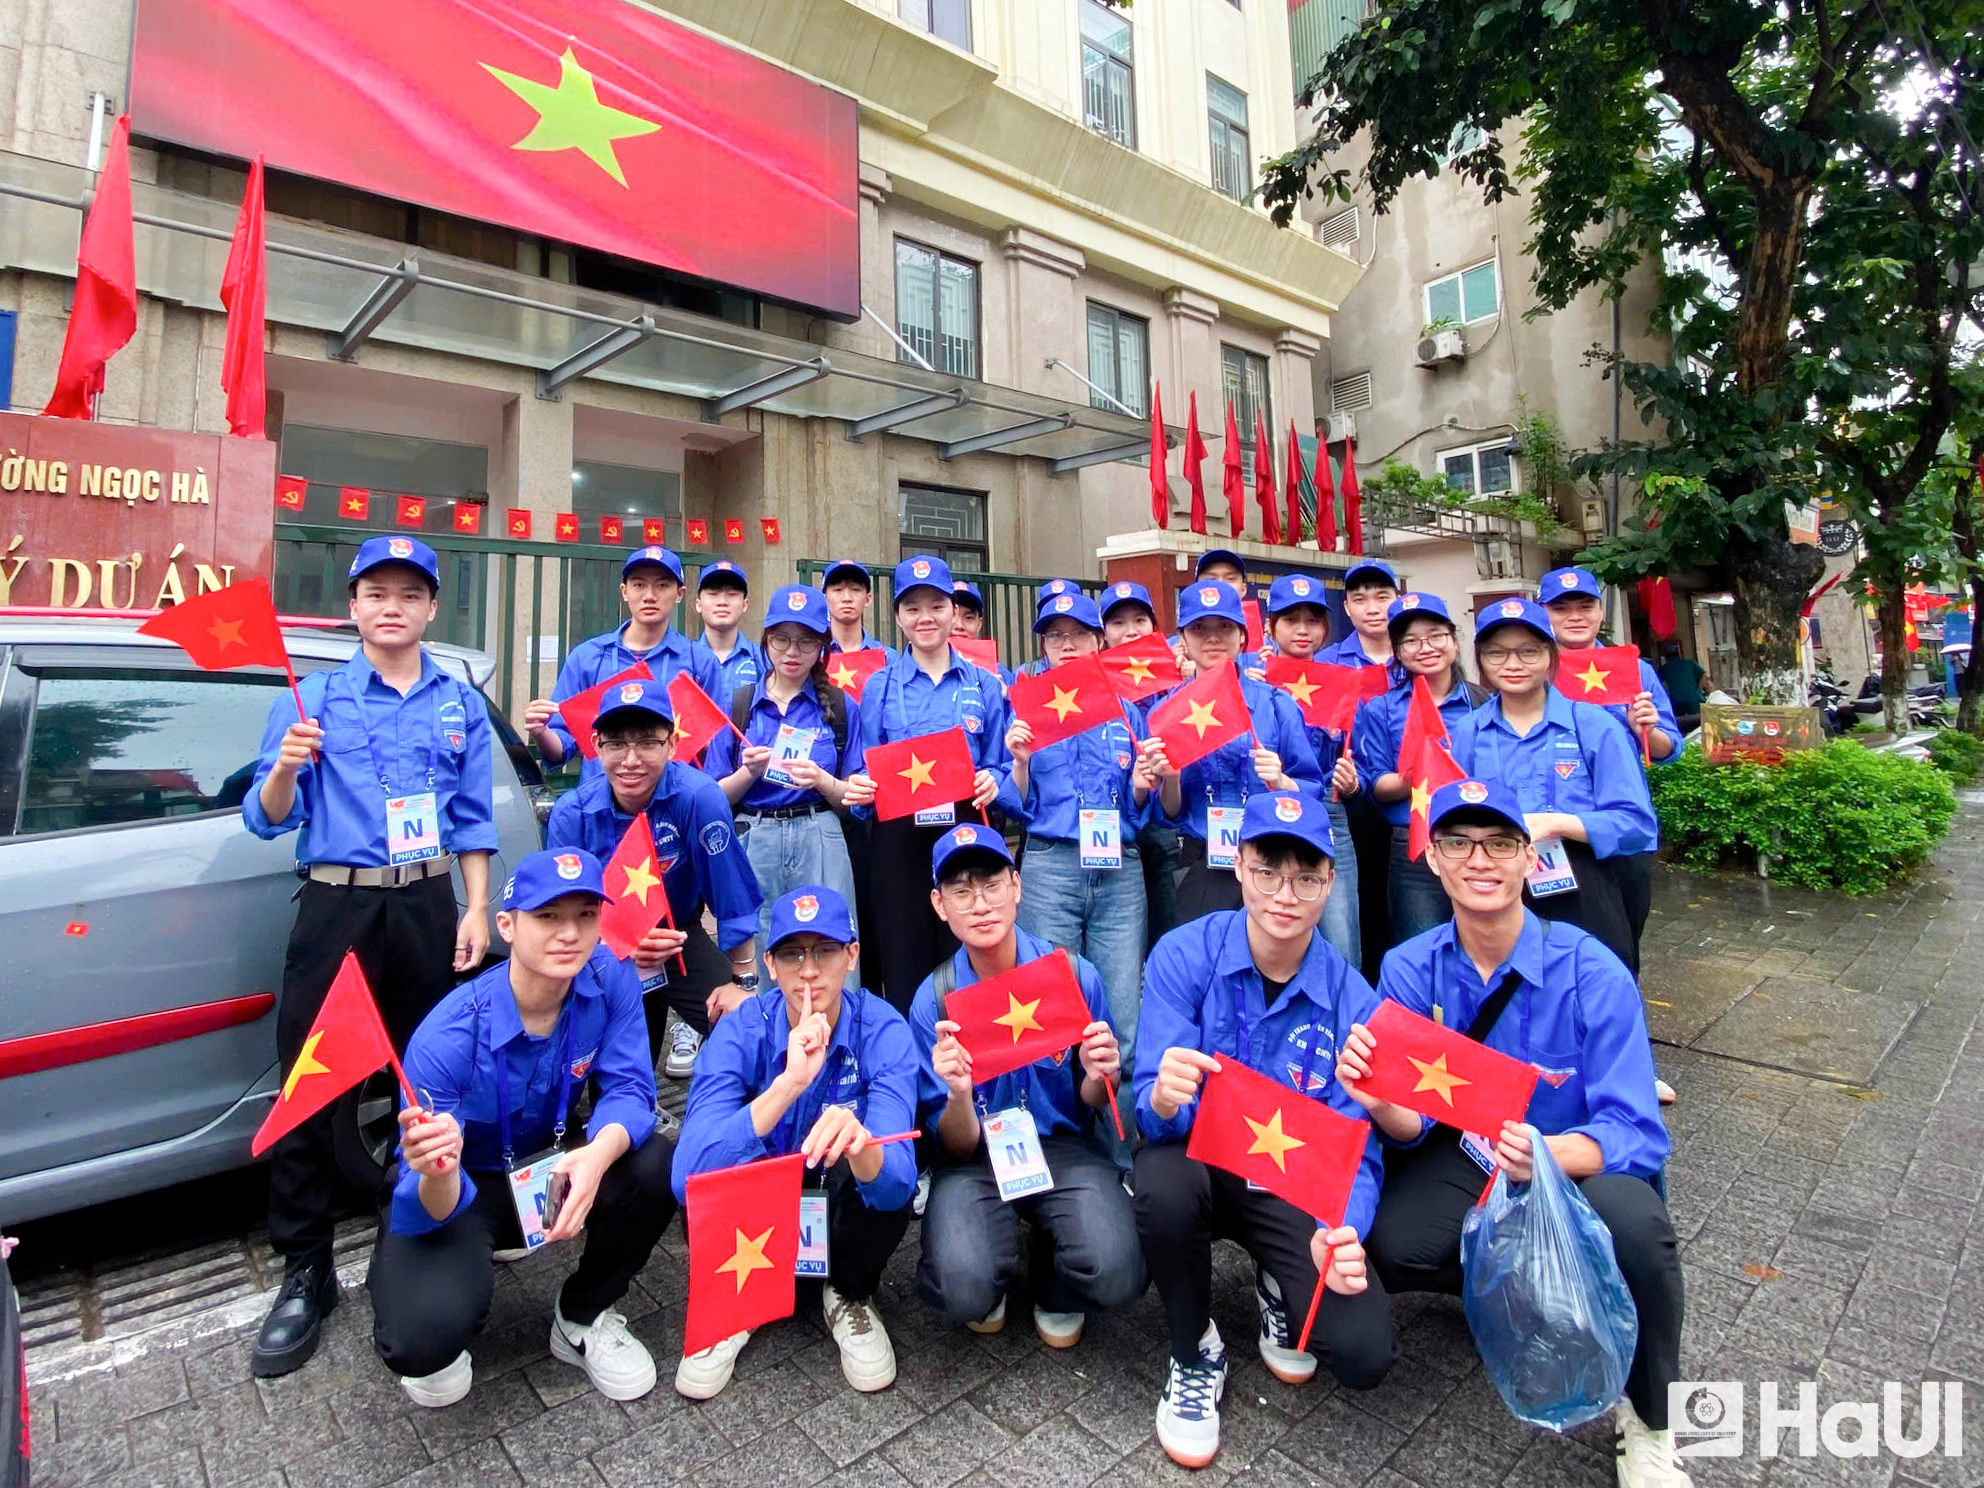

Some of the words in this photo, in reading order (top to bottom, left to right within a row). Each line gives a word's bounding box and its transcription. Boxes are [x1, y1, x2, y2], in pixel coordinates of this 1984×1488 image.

[0, 448, 68, 494] ỜNG
[80, 464, 160, 507] NGỌC
[171, 467, 209, 504] HÀ
[403, 818, 424, 840] N
[1221, 829, 1238, 846] N
[1092, 830, 1108, 847] N
[396, 850, 421, 862] PHỤC
[422, 847, 435, 857] VỤ
[1535, 881, 1558, 892] PHỤC
[1558, 879, 1571, 888] VỤ
[1006, 1142, 1029, 1167] N
[1006, 1178, 1031, 1192] PHỤC
[1031, 1175, 1044, 1185] VỤ
[809, 1261, 822, 1273] VỤ
